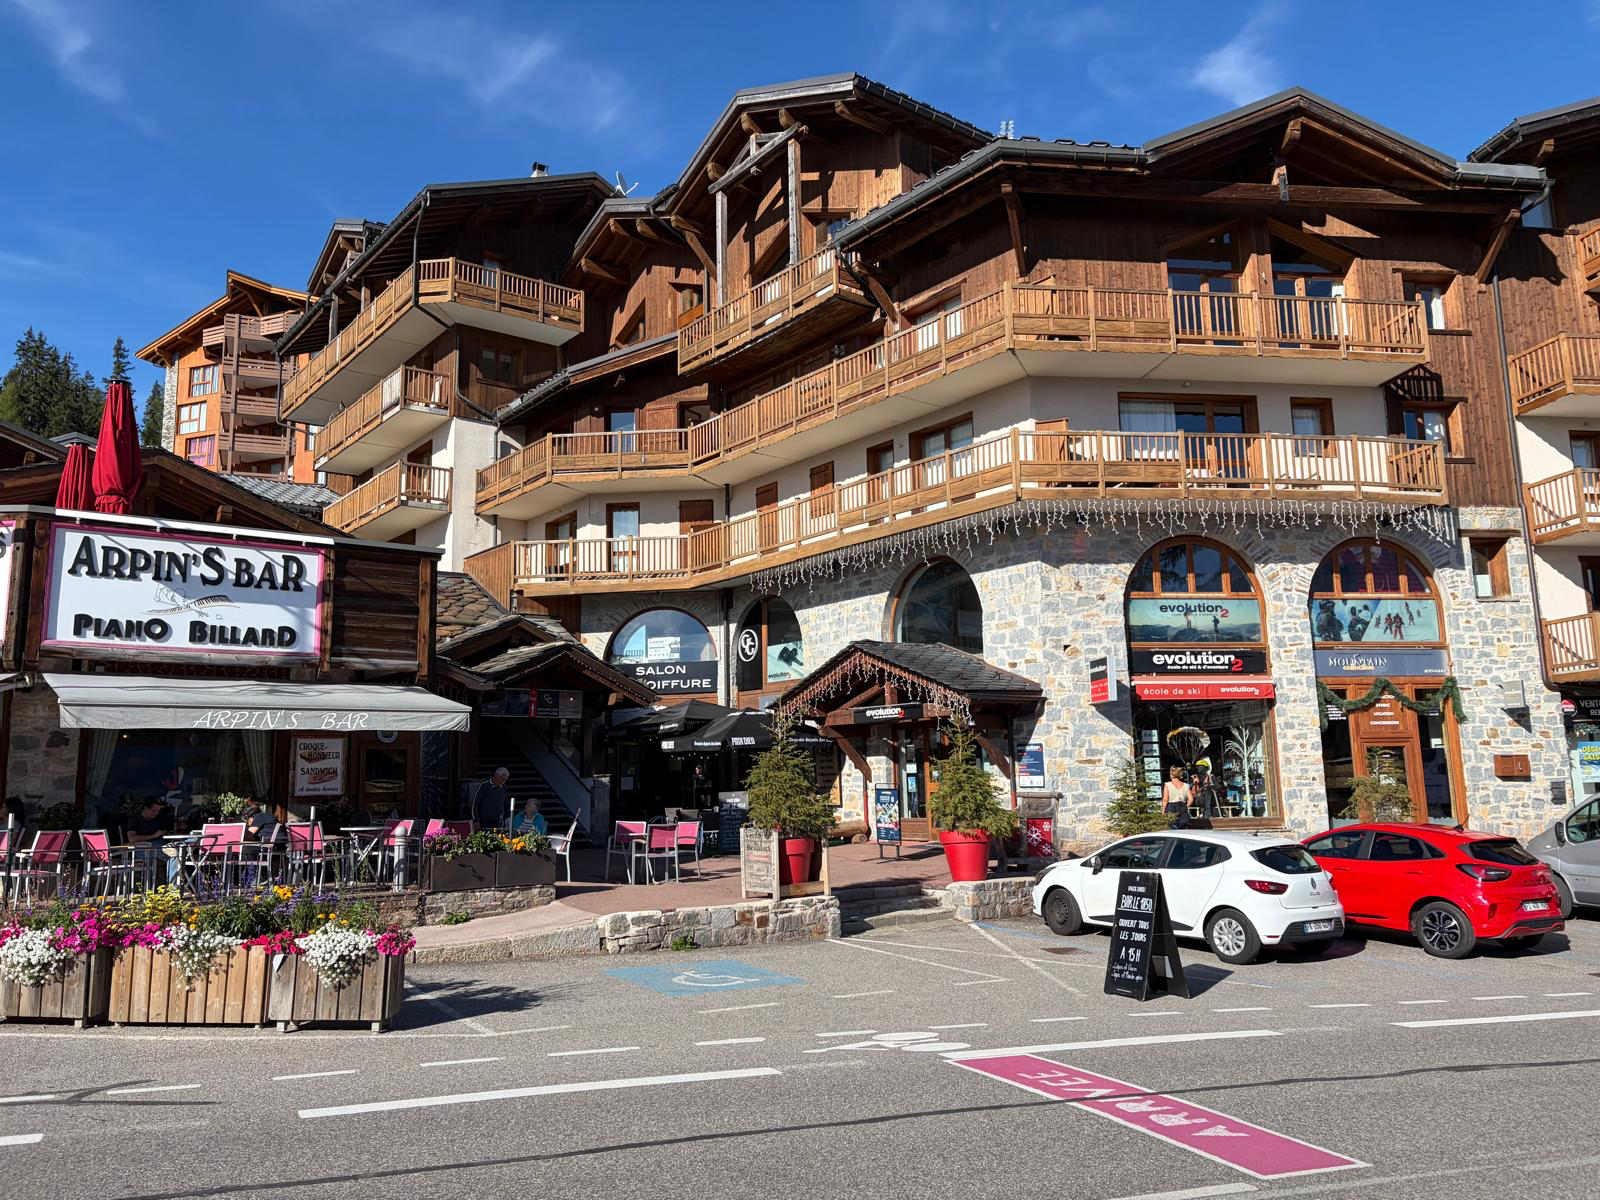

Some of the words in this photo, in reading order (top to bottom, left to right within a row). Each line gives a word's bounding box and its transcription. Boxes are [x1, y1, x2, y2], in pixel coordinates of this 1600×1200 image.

[67, 536, 226, 587] ARPIN'S
[234, 554, 305, 593] BAR
[73, 614, 169, 642] PIANO
[189, 622, 297, 648] BILLARD
[636, 665, 686, 676] SALON
[646, 679, 712, 690] OIFFURE
[1143, 687, 1169, 695] école
[1172, 687, 1184, 695] de
[1187, 686, 1201, 695] ski
[1580, 700, 1600, 708] VENT
[193, 710, 300, 730] ARPIN'S
[320, 712, 369, 730] BAR
[300, 767, 338, 776] SANDWICH
[1121, 894, 1133, 909] BAR
[1132, 896, 1140, 910] LE
[1119, 918, 1137, 928] OUVERT
[1138, 920, 1150, 930] TOUS
[1119, 931, 1129, 940] LES
[1130, 932, 1147, 942] JOURS
[1119, 946, 1126, 960] A
